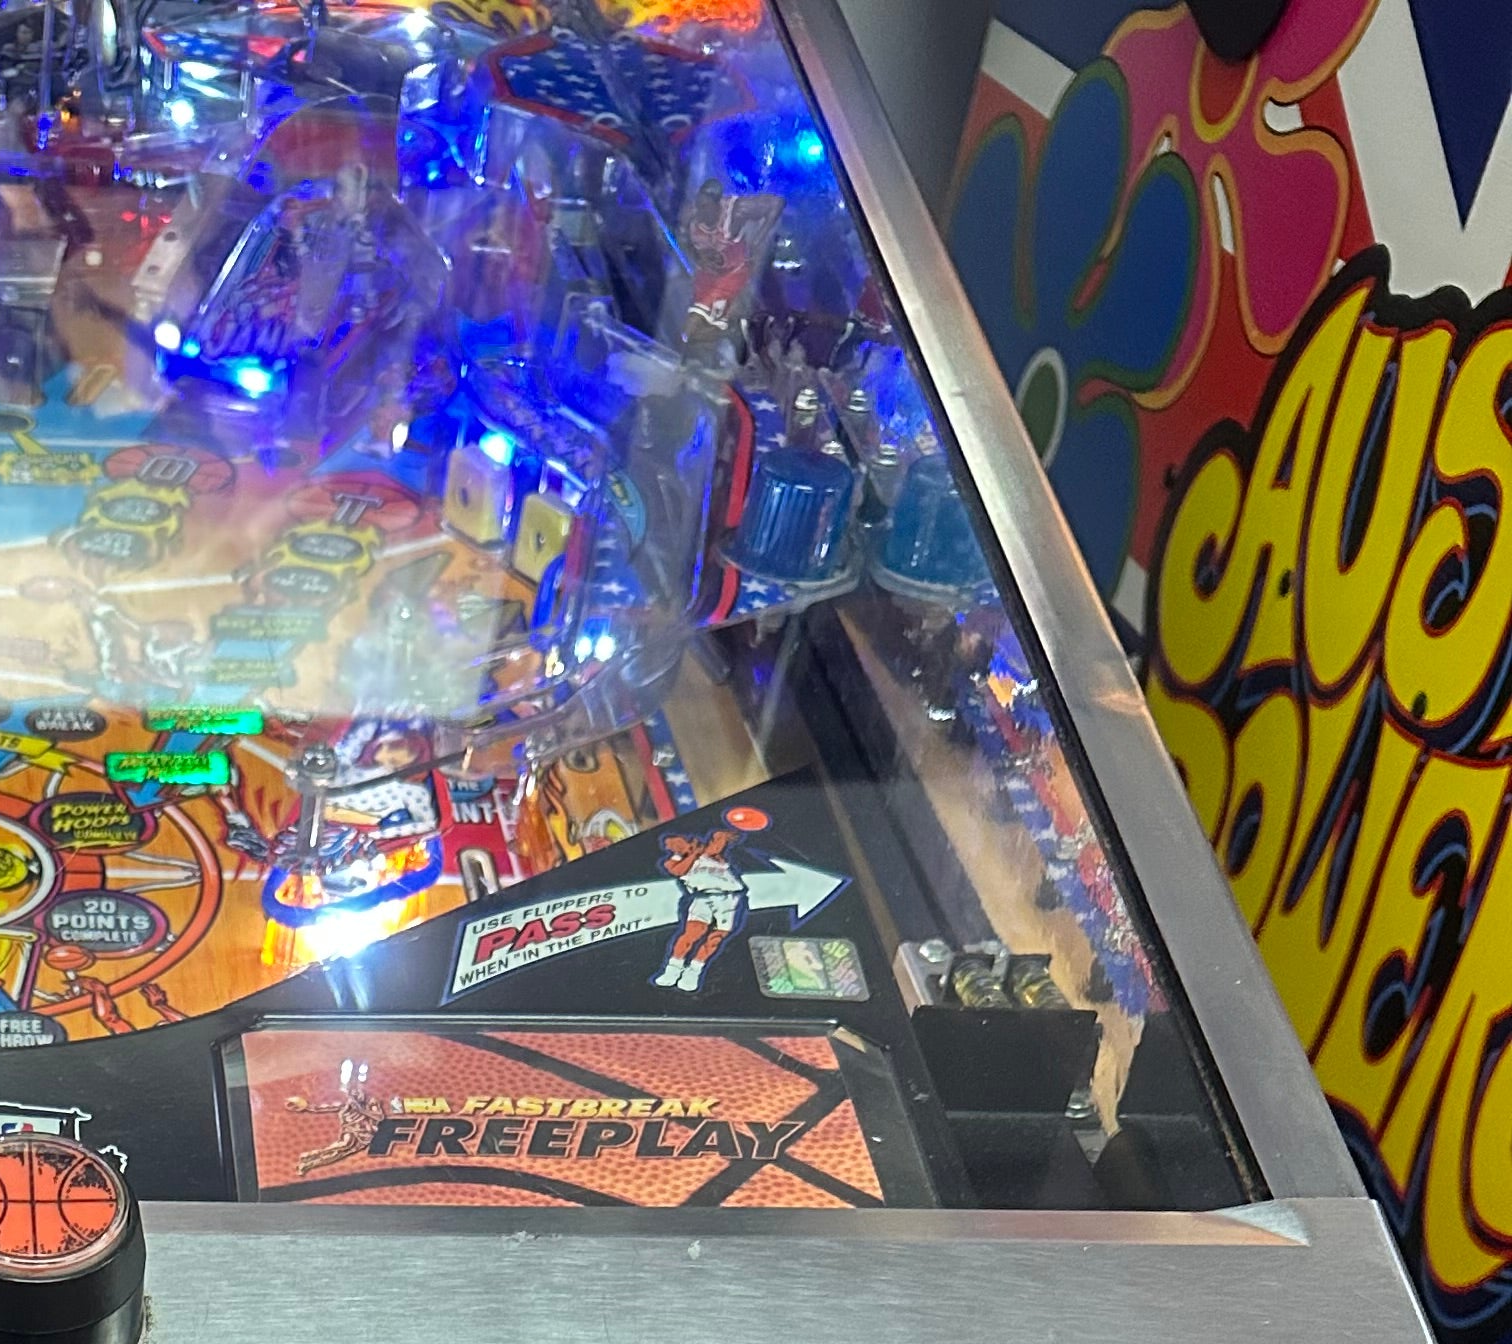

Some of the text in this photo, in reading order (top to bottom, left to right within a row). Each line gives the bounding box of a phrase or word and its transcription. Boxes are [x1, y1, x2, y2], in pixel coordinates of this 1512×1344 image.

[51, 803, 128, 819] POWER
[52, 815, 130, 833] HOOPS
[85, 901, 117, 915] 20
[472, 886, 648, 935] USE FLIPPERS TO
[51, 914, 150, 930] POINTS
[61, 928, 138, 943] COMPLETE
[472, 903, 617, 966] PASS
[459, 956, 509, 987] WHEN
[547, 934, 584, 953] THE
[0, 1019, 43, 1034] FREE
[404, 1096, 722, 1118] NBA FASTBREAK
[367, 1117, 804, 1160] FREEPLAY
